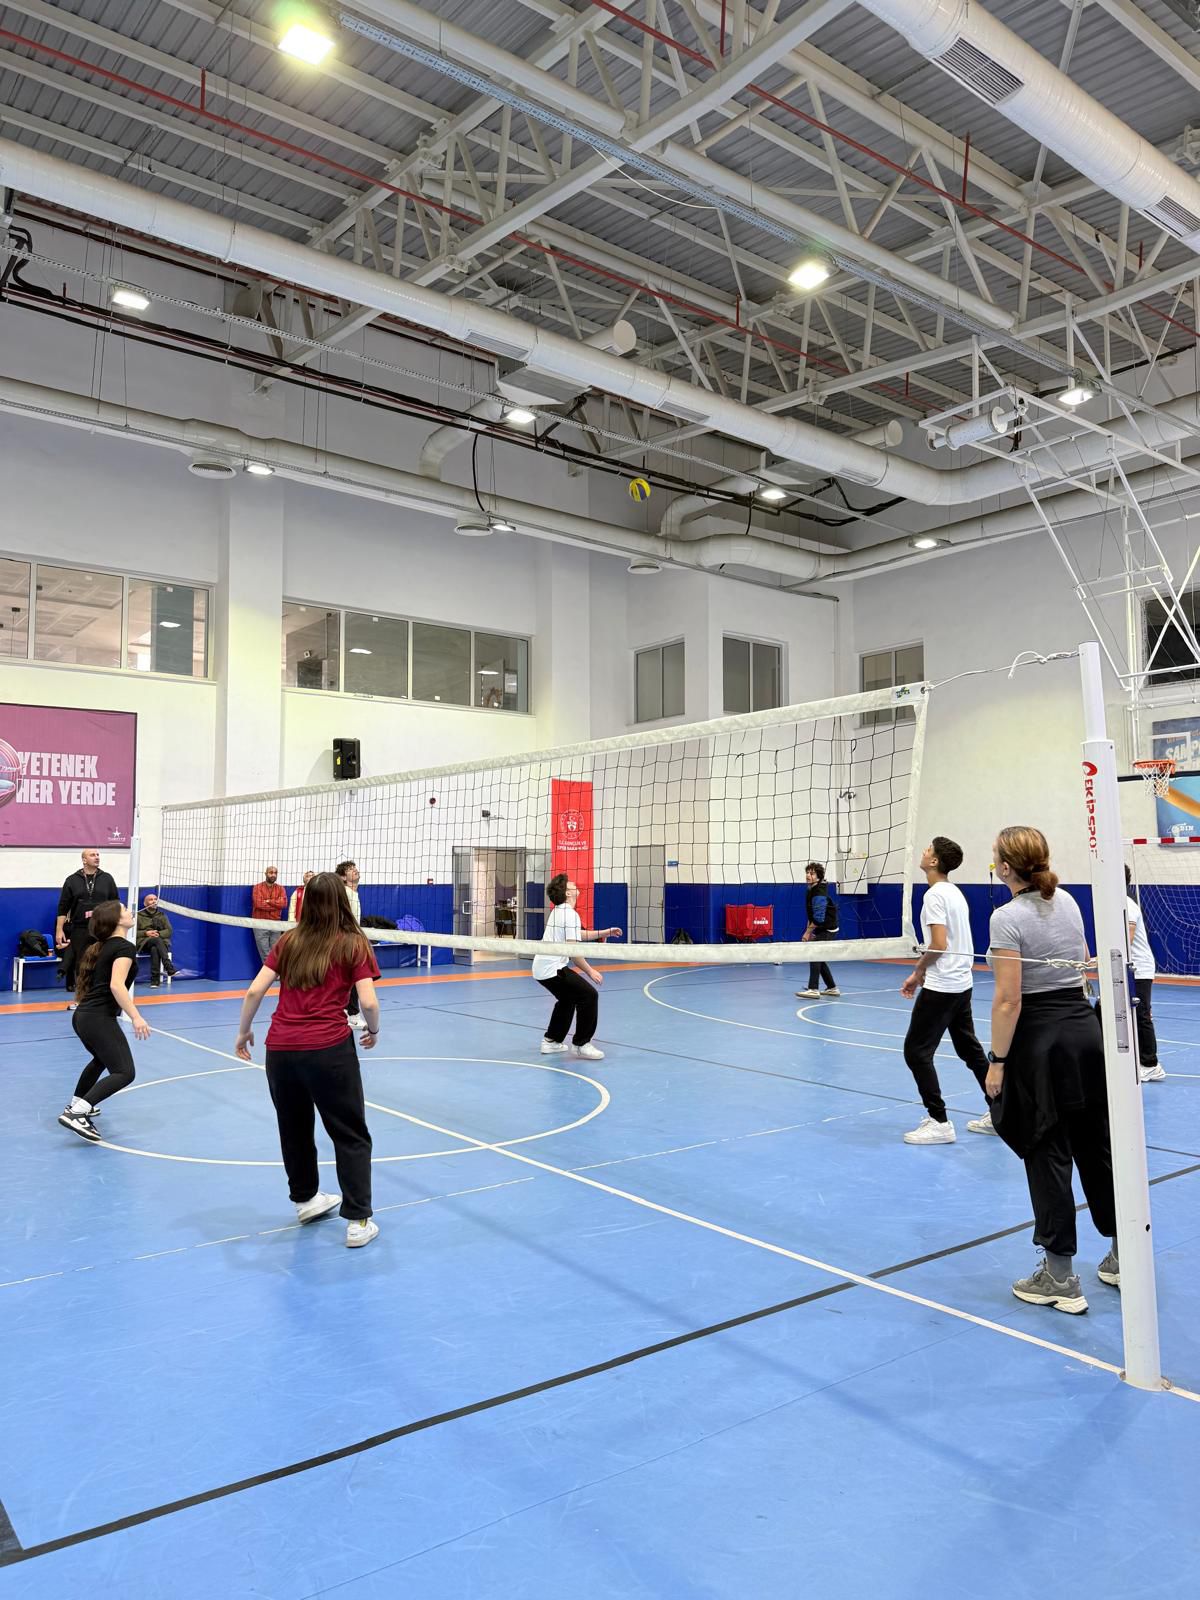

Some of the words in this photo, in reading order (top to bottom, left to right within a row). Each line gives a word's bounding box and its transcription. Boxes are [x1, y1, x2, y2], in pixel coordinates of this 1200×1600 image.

[17, 752, 99, 779] YETENEK
[16, 778, 54, 804] HER
[58, 780, 117, 806] YERDE
